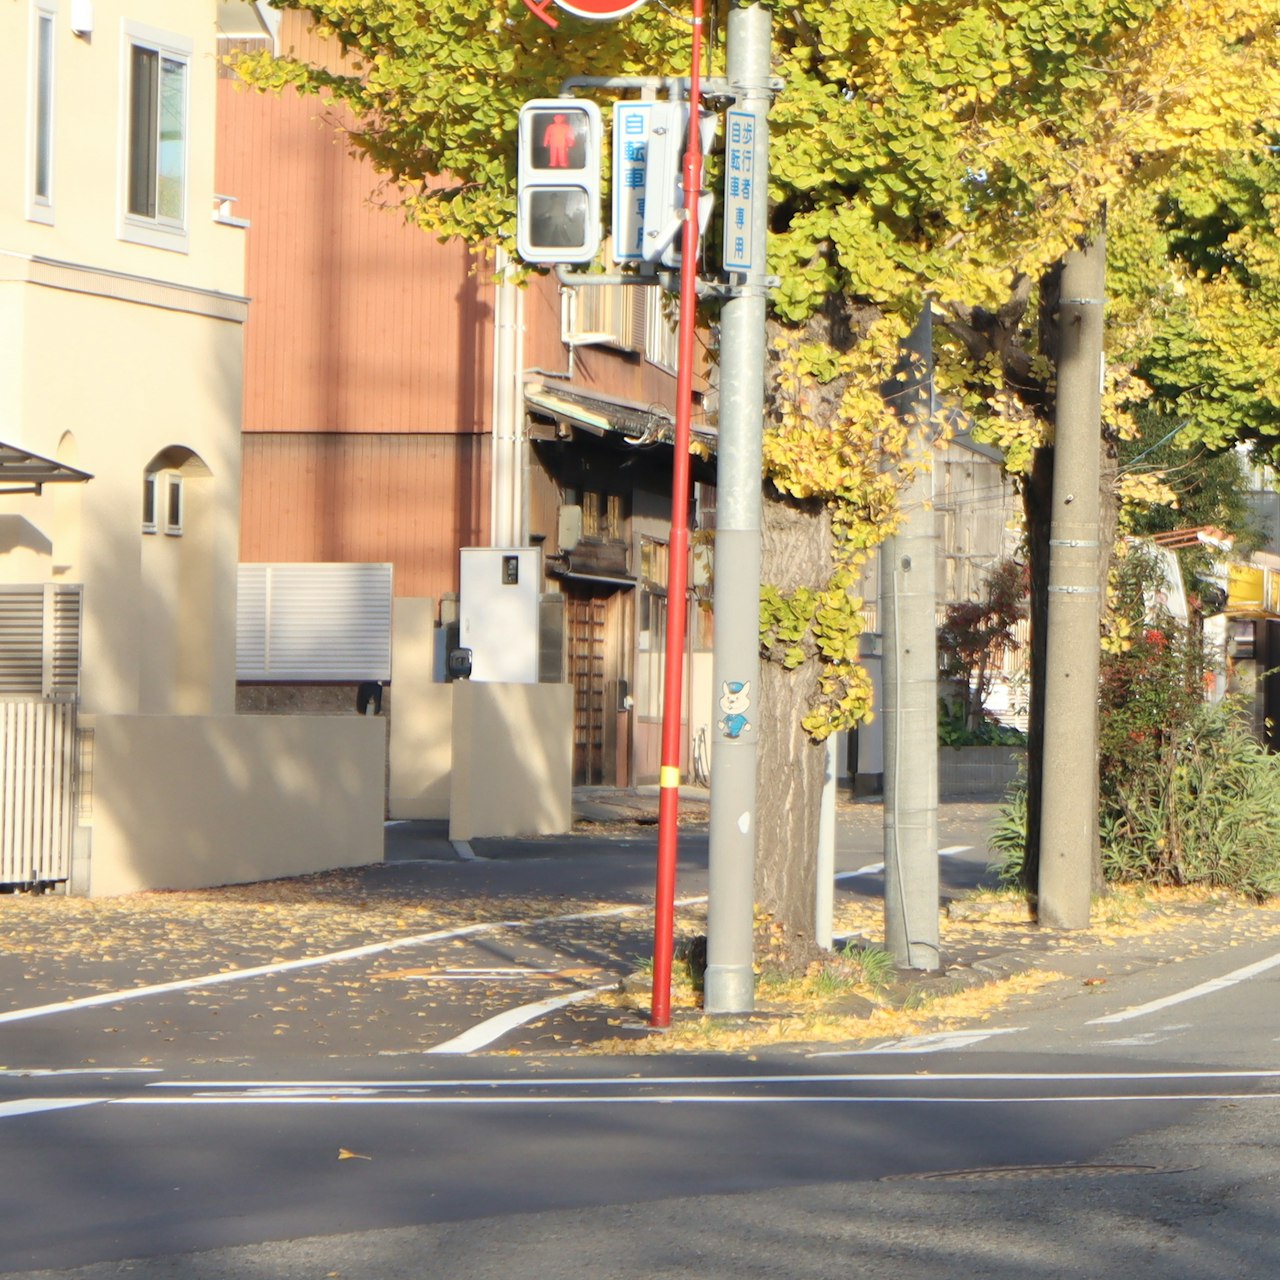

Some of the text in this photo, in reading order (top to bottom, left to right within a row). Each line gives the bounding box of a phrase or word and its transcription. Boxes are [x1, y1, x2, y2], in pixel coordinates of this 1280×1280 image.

[730, 122, 741, 199] 自転車
[741, 121, 753, 200] 歩行者
[734, 207, 745, 259] 専用
